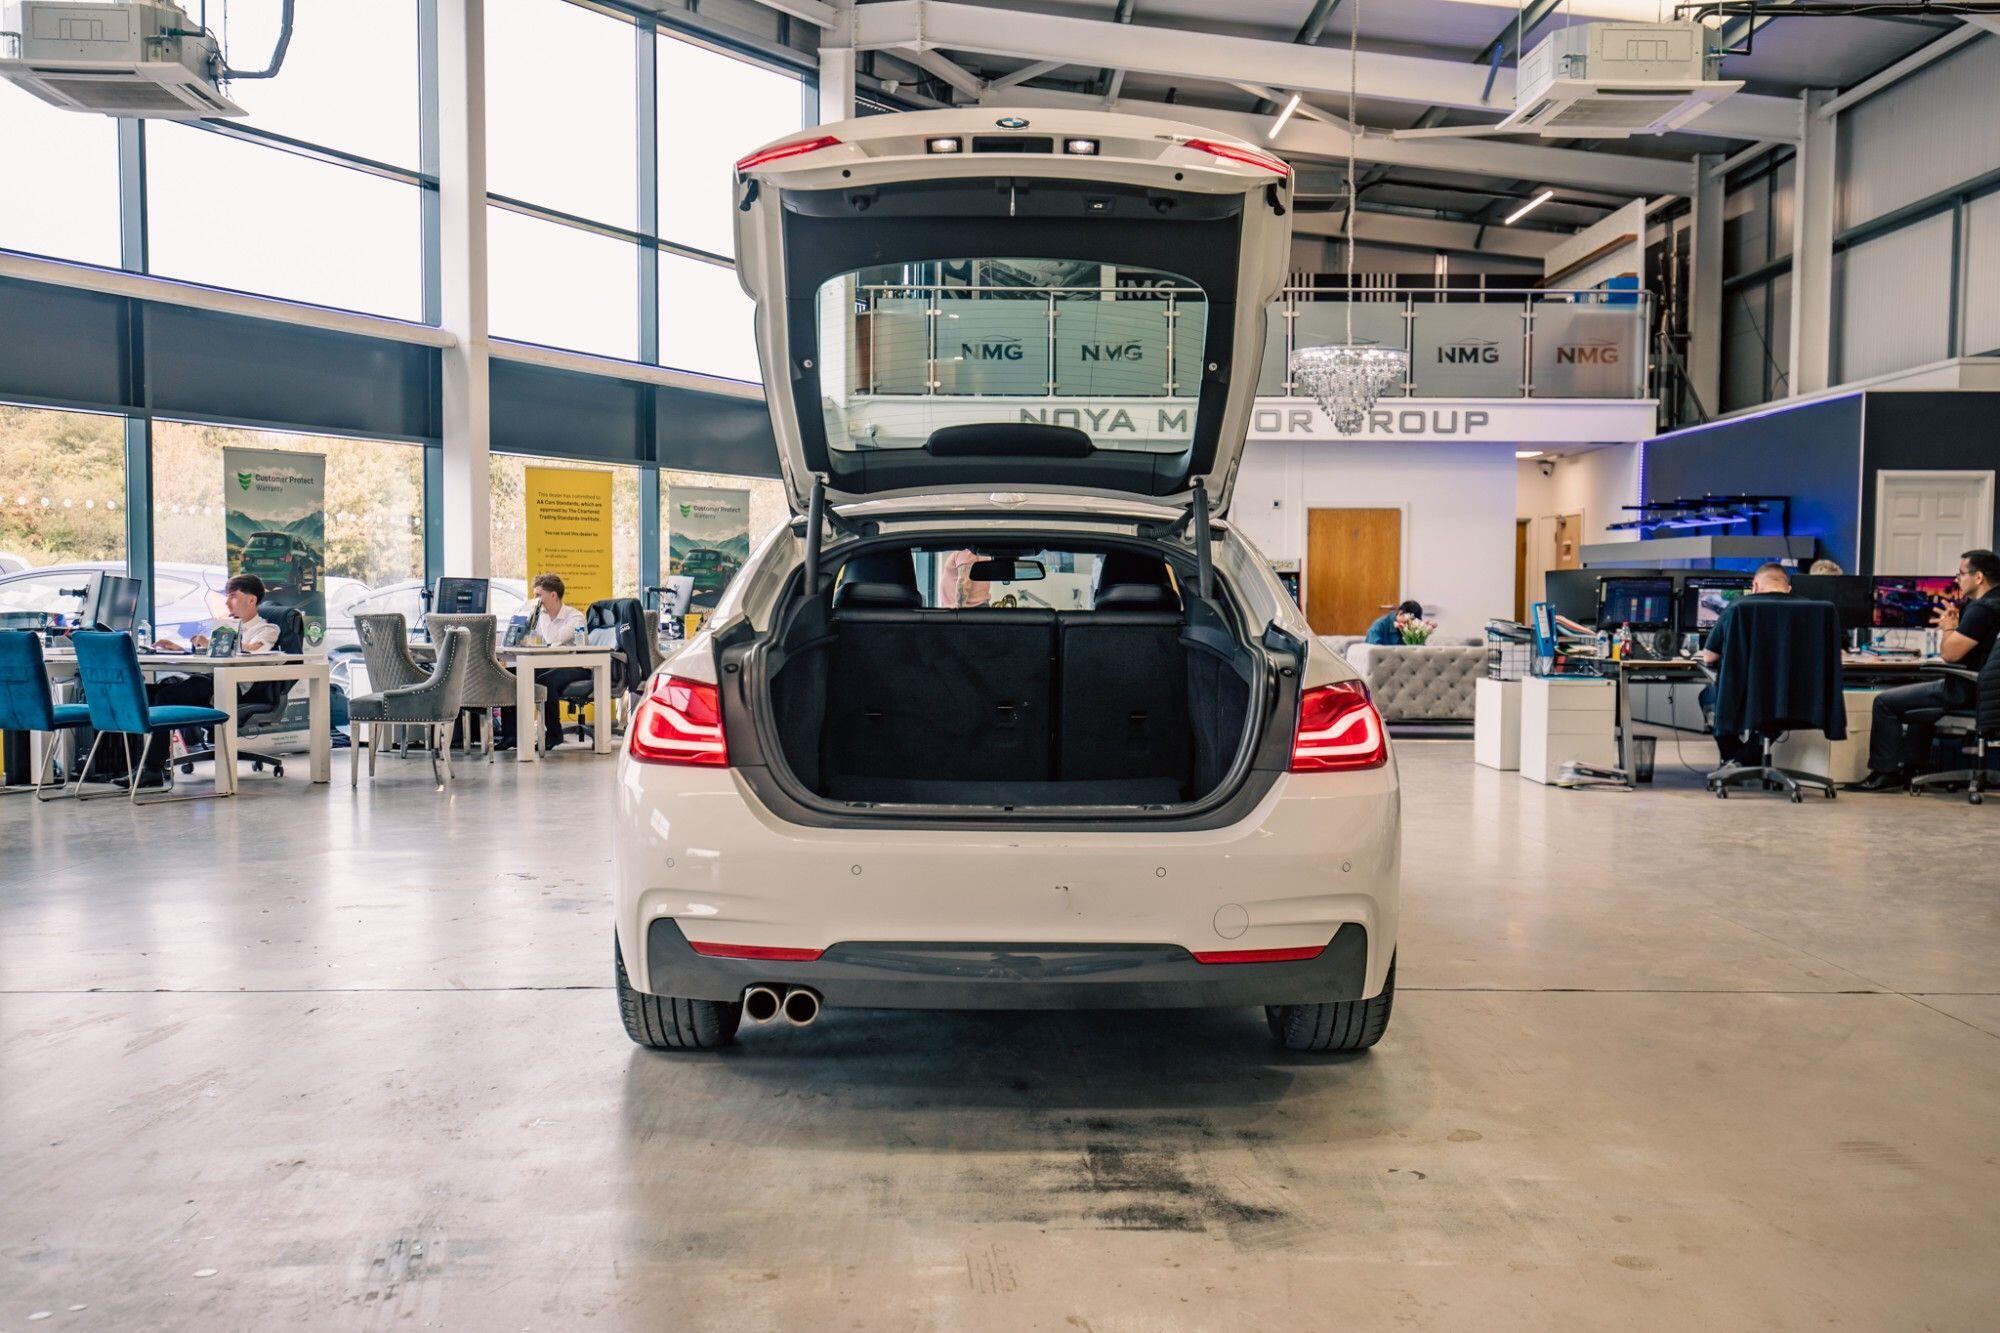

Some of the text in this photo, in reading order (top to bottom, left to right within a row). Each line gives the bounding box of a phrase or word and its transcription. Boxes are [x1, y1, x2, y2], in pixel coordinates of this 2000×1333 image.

[961, 343, 1023, 361] NMG
[1081, 344, 1143, 361] NMG
[1438, 346, 1499, 363] NMG
[1557, 347, 1618, 364] NMG
[1020, 408, 1136, 432] NOYA
[255, 474, 314, 485] Customer Protect
[256, 484, 283, 493] Warranty
